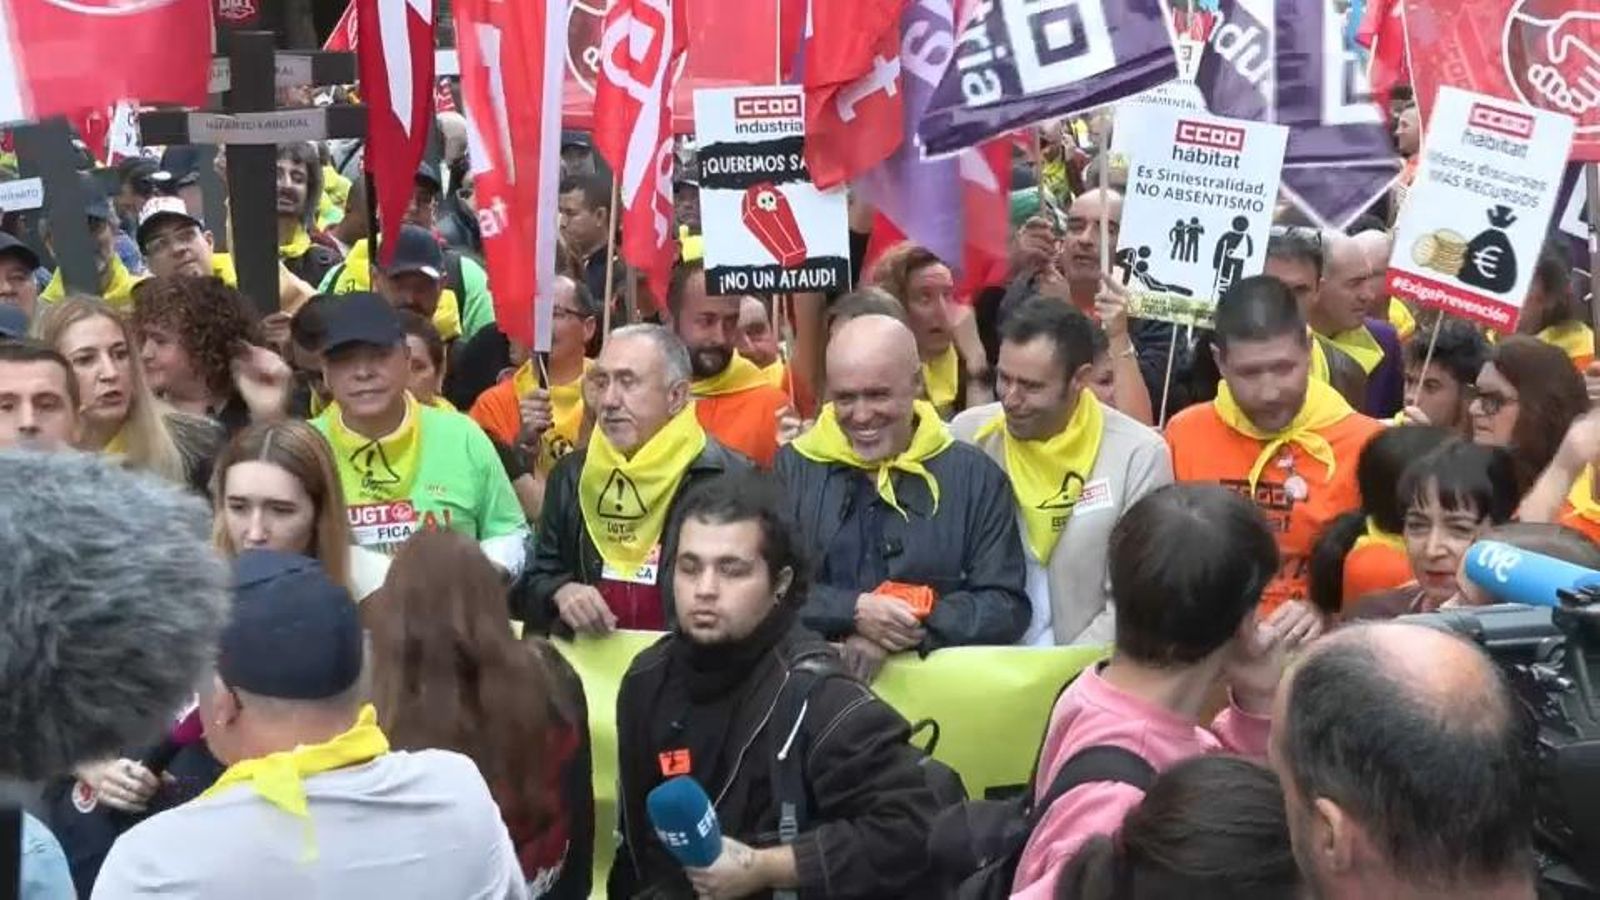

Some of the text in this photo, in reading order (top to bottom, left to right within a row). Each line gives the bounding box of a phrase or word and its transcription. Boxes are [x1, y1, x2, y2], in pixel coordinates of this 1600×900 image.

[735, 119, 803, 134] industria
[1178, 122, 1243, 149] CCOO
[702, 154, 785, 178] ¡QUEREMOS
[1172, 145, 1240, 168] hábitat
[1137, 165, 1153, 179] Es
[1136, 182, 1264, 213] NO ABSENTISMO
[719, 267, 837, 294] ¡NO UN ATAUD!
[347, 505, 391, 526] UGT
[378, 525, 411, 540] FICA
